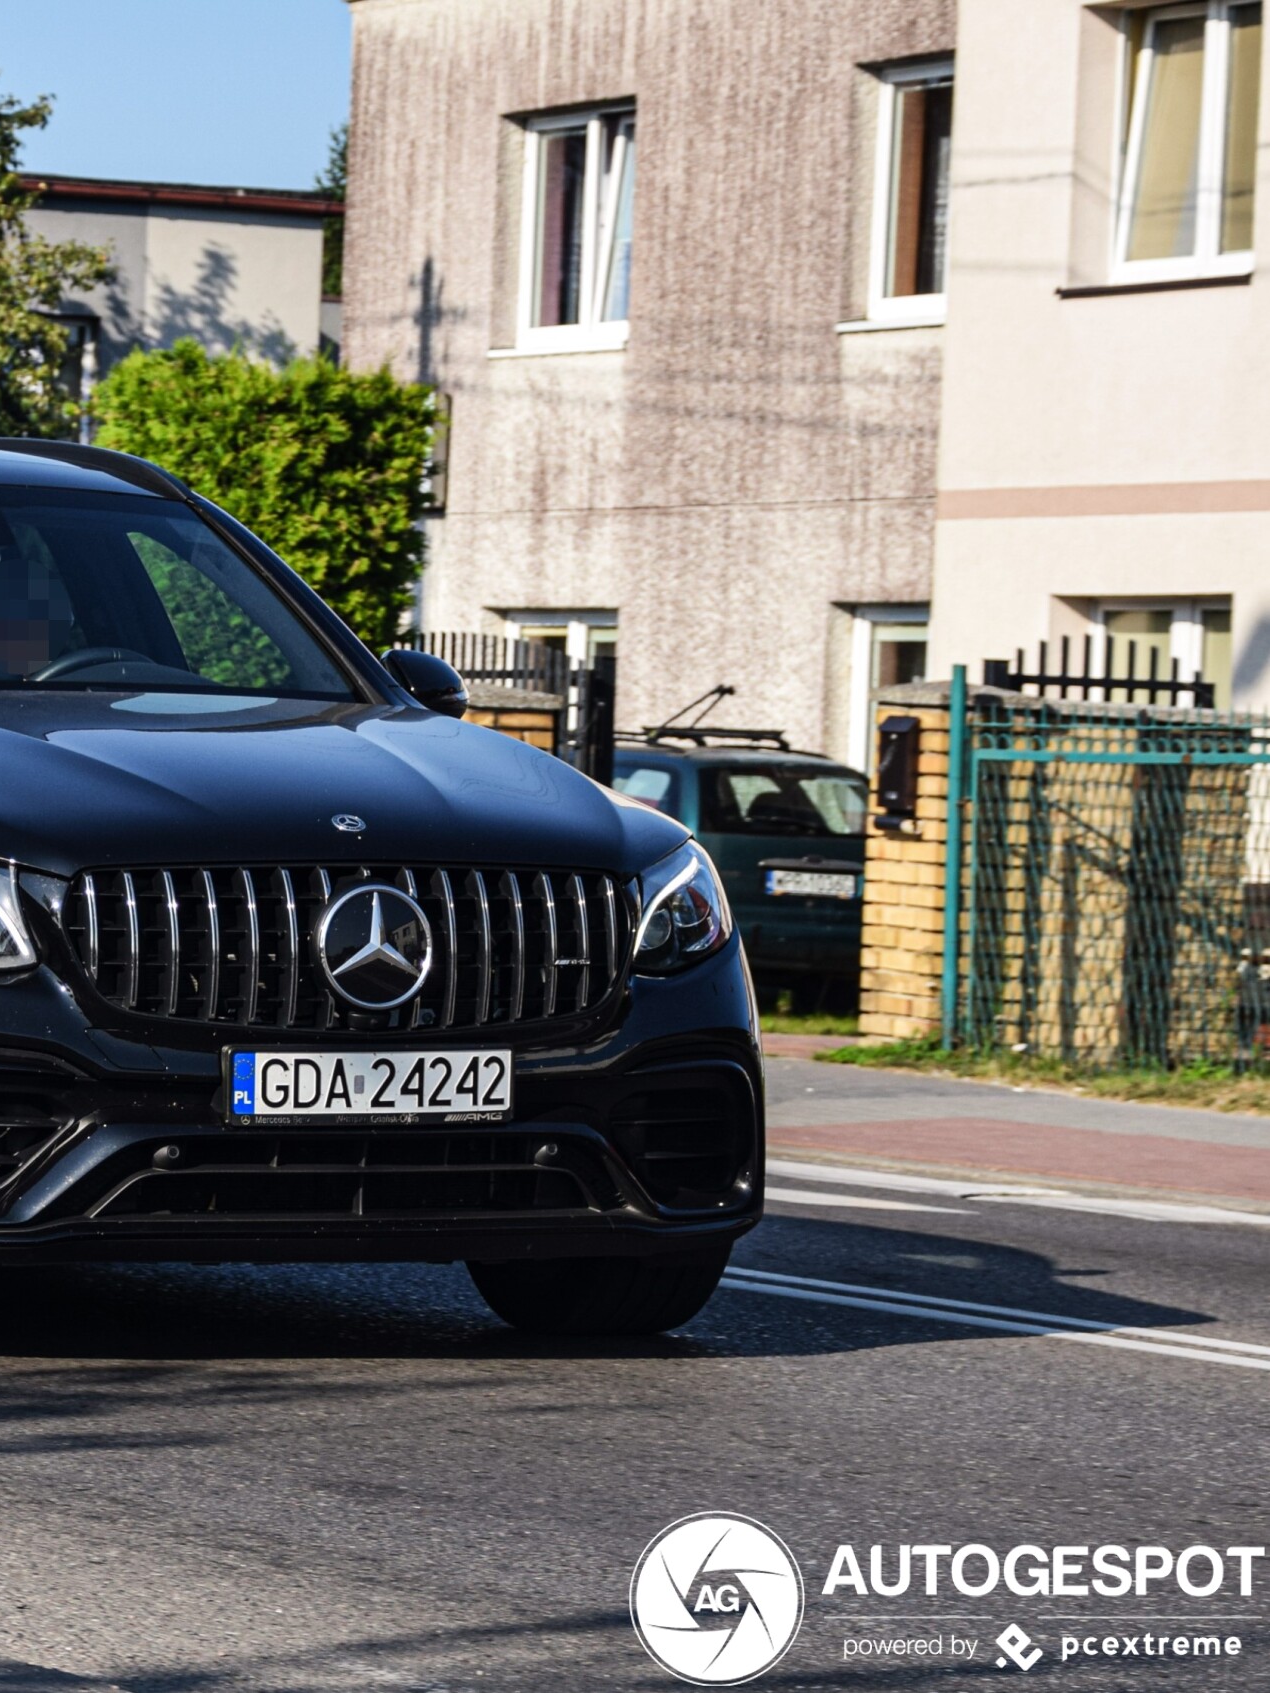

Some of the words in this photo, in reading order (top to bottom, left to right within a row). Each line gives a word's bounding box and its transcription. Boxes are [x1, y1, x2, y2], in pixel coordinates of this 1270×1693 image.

[261, 1057, 352, 1109] GDA
[370, 1055, 506, 1108] 24242
[233, 1091, 252, 1105] PL
[465, 1112, 503, 1121] AMG
